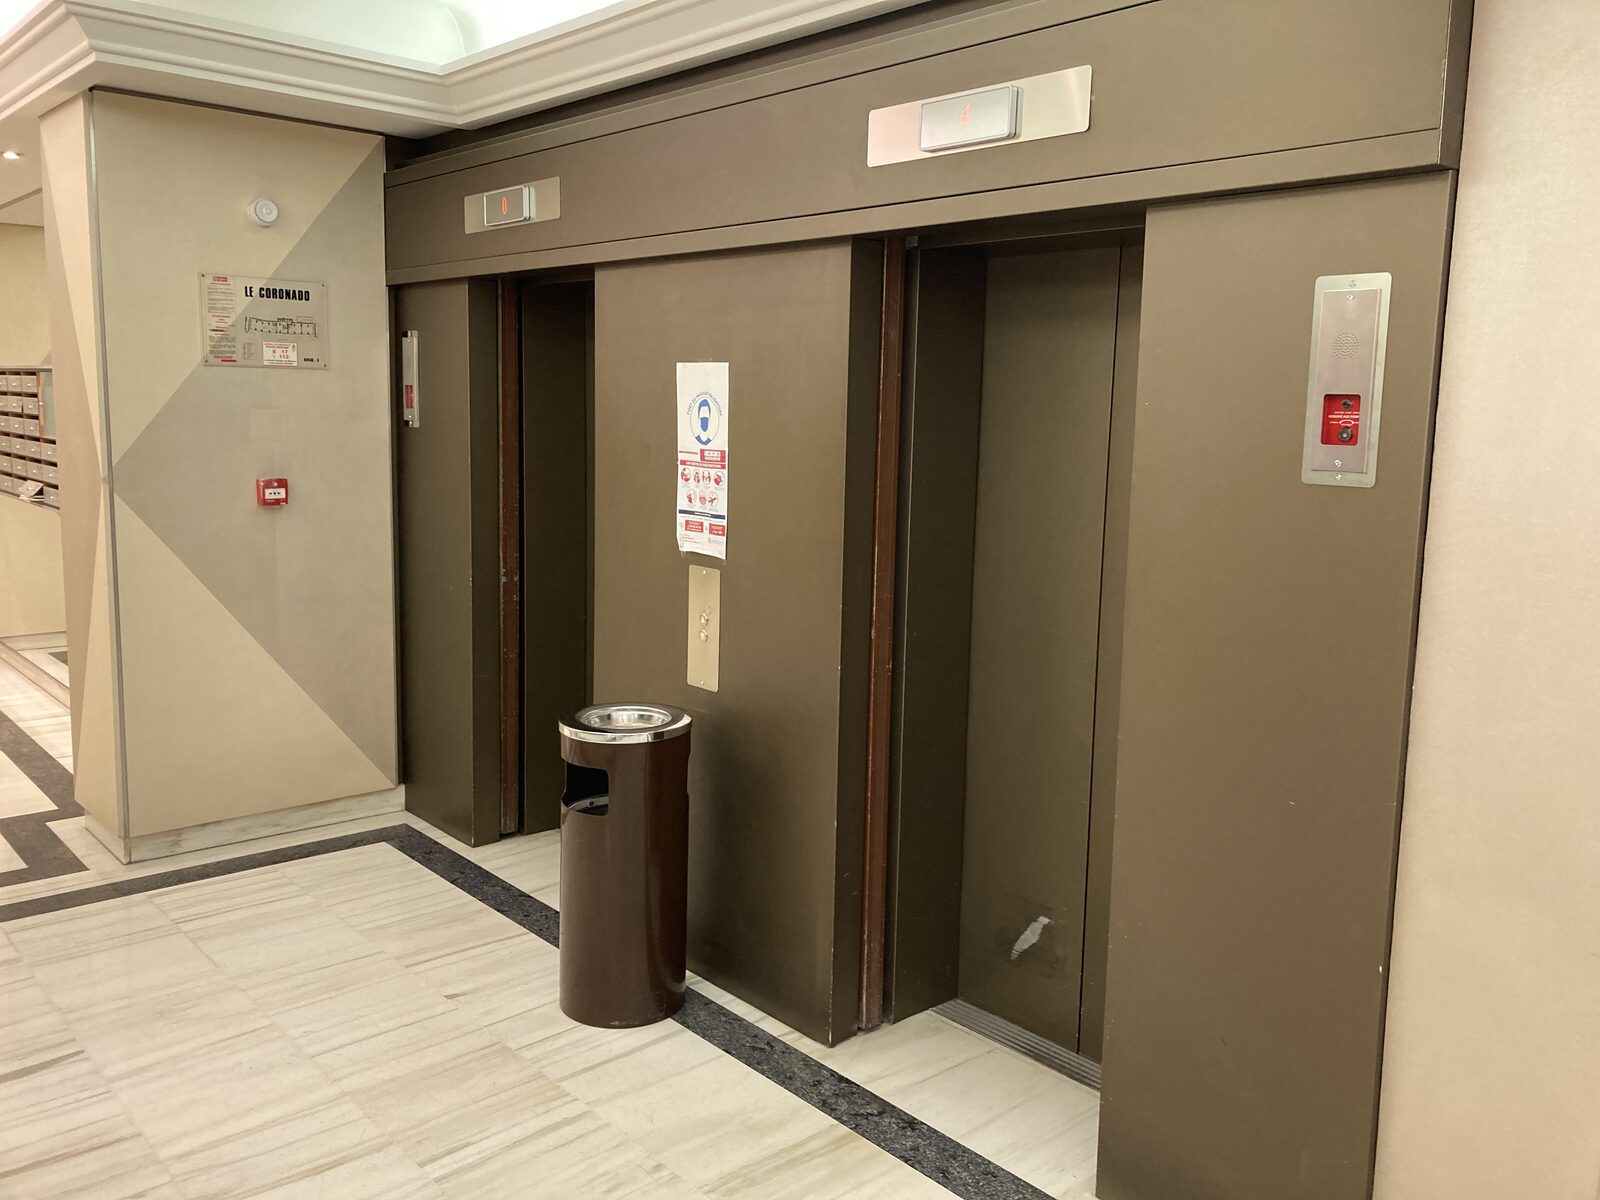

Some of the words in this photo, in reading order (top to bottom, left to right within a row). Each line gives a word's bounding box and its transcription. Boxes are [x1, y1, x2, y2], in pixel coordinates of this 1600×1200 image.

[501, 196, 508, 216] 0
[244, 286, 255, 297] LE
[259, 287, 310, 301] CORONADO
